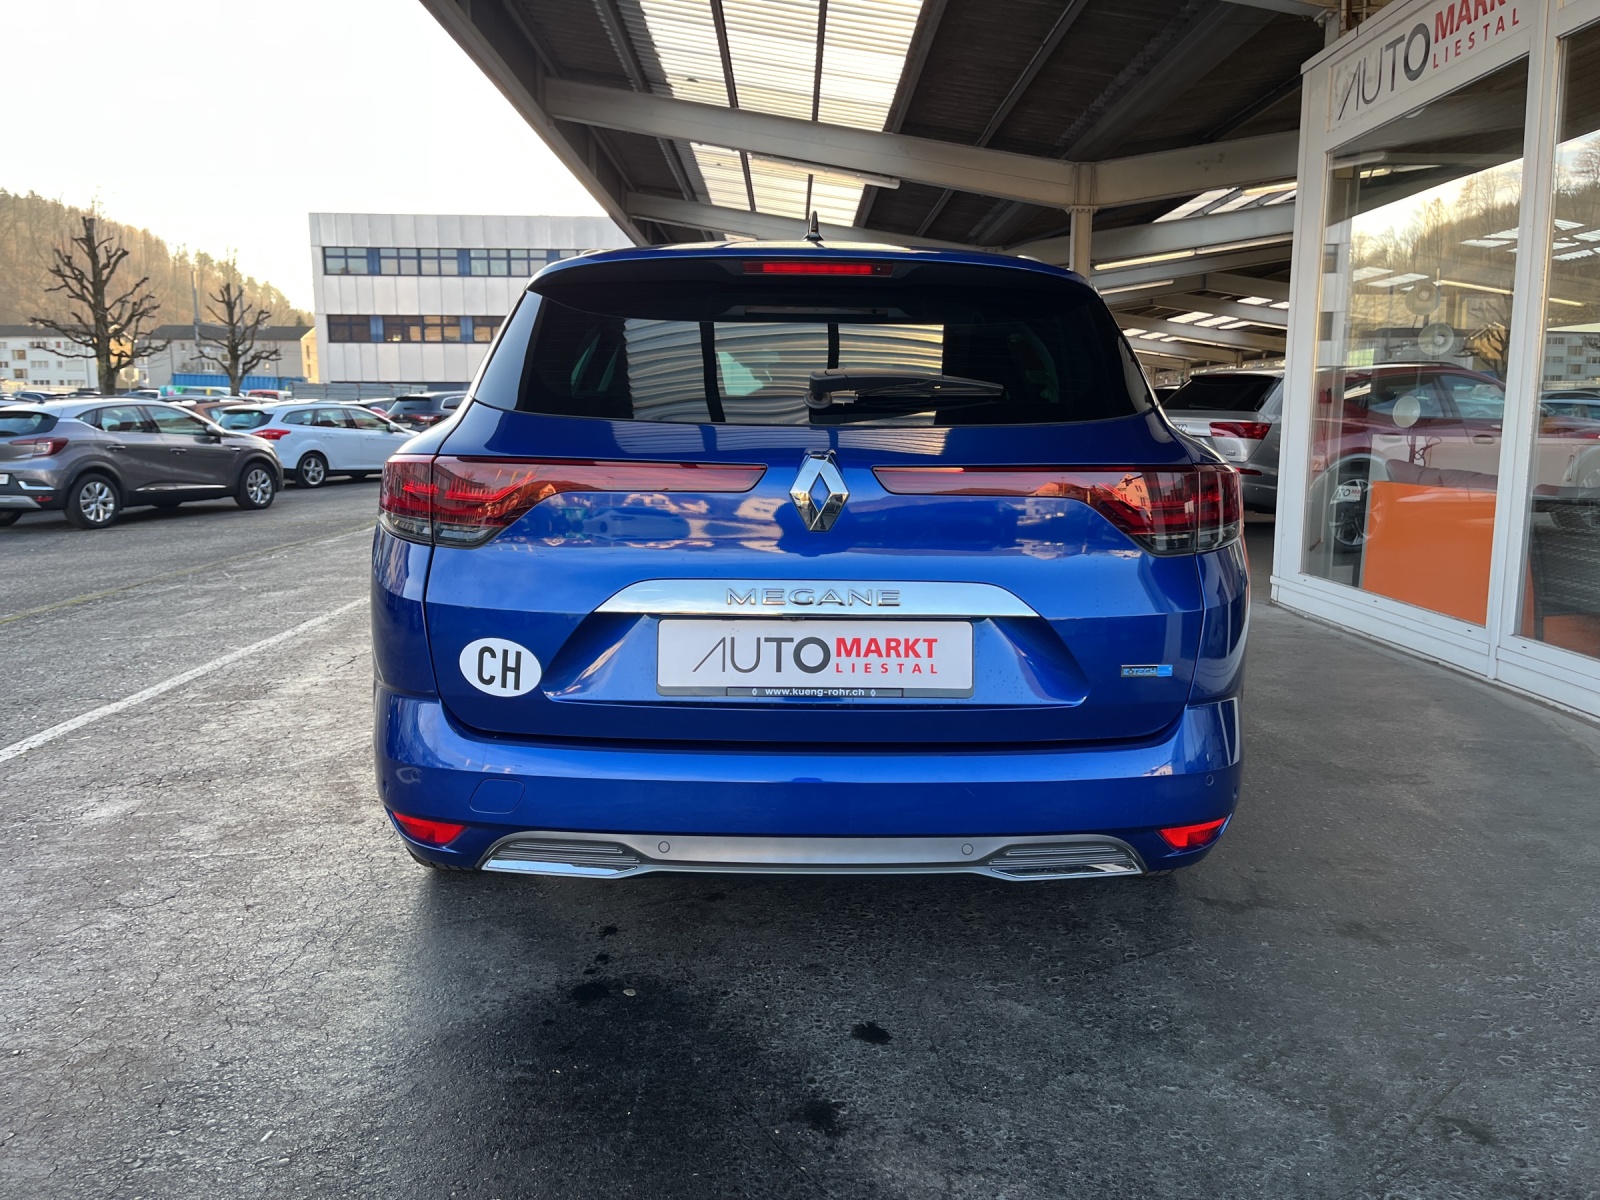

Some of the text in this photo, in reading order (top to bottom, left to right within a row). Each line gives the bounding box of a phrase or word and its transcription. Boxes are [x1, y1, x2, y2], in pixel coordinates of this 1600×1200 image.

[1433, 7, 1520, 69] LIESTAL
[1337, 22, 1431, 121] AUTO
[726, 587, 900, 607] MEGANE
[477, 645, 522, 691] CH
[692, 636, 938, 674] AUTO MARKT
[835, 662, 938, 674] LIESTAL
[764, 687, 865, 698] www.kueng-rohr.ch
